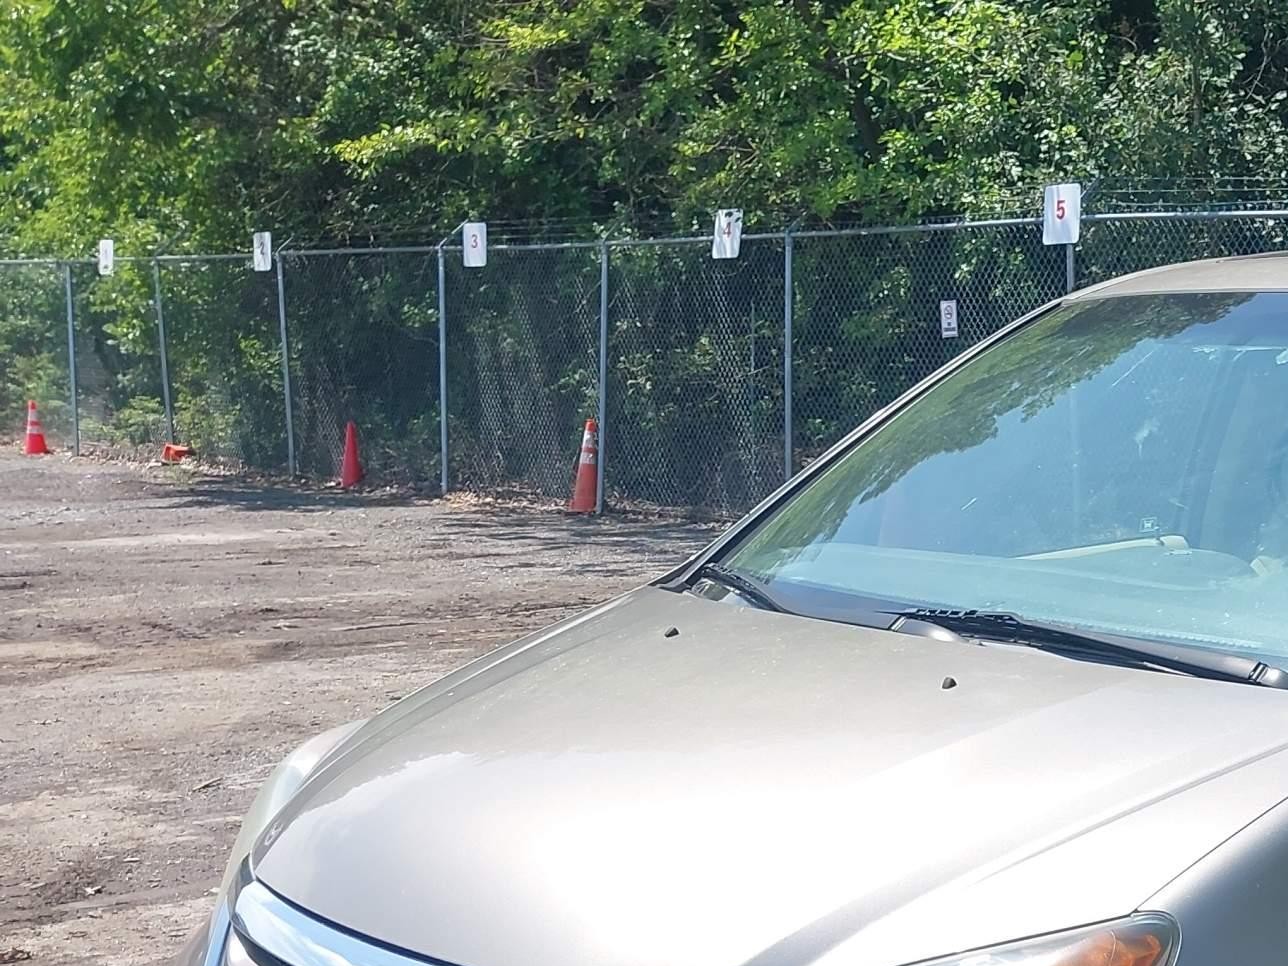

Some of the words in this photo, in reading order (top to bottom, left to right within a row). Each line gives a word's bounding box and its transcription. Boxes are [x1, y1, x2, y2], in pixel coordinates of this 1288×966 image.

[1056, 199, 1066, 220] 5
[723, 221, 731, 239] 4
[471, 233, 478, 249] 3
